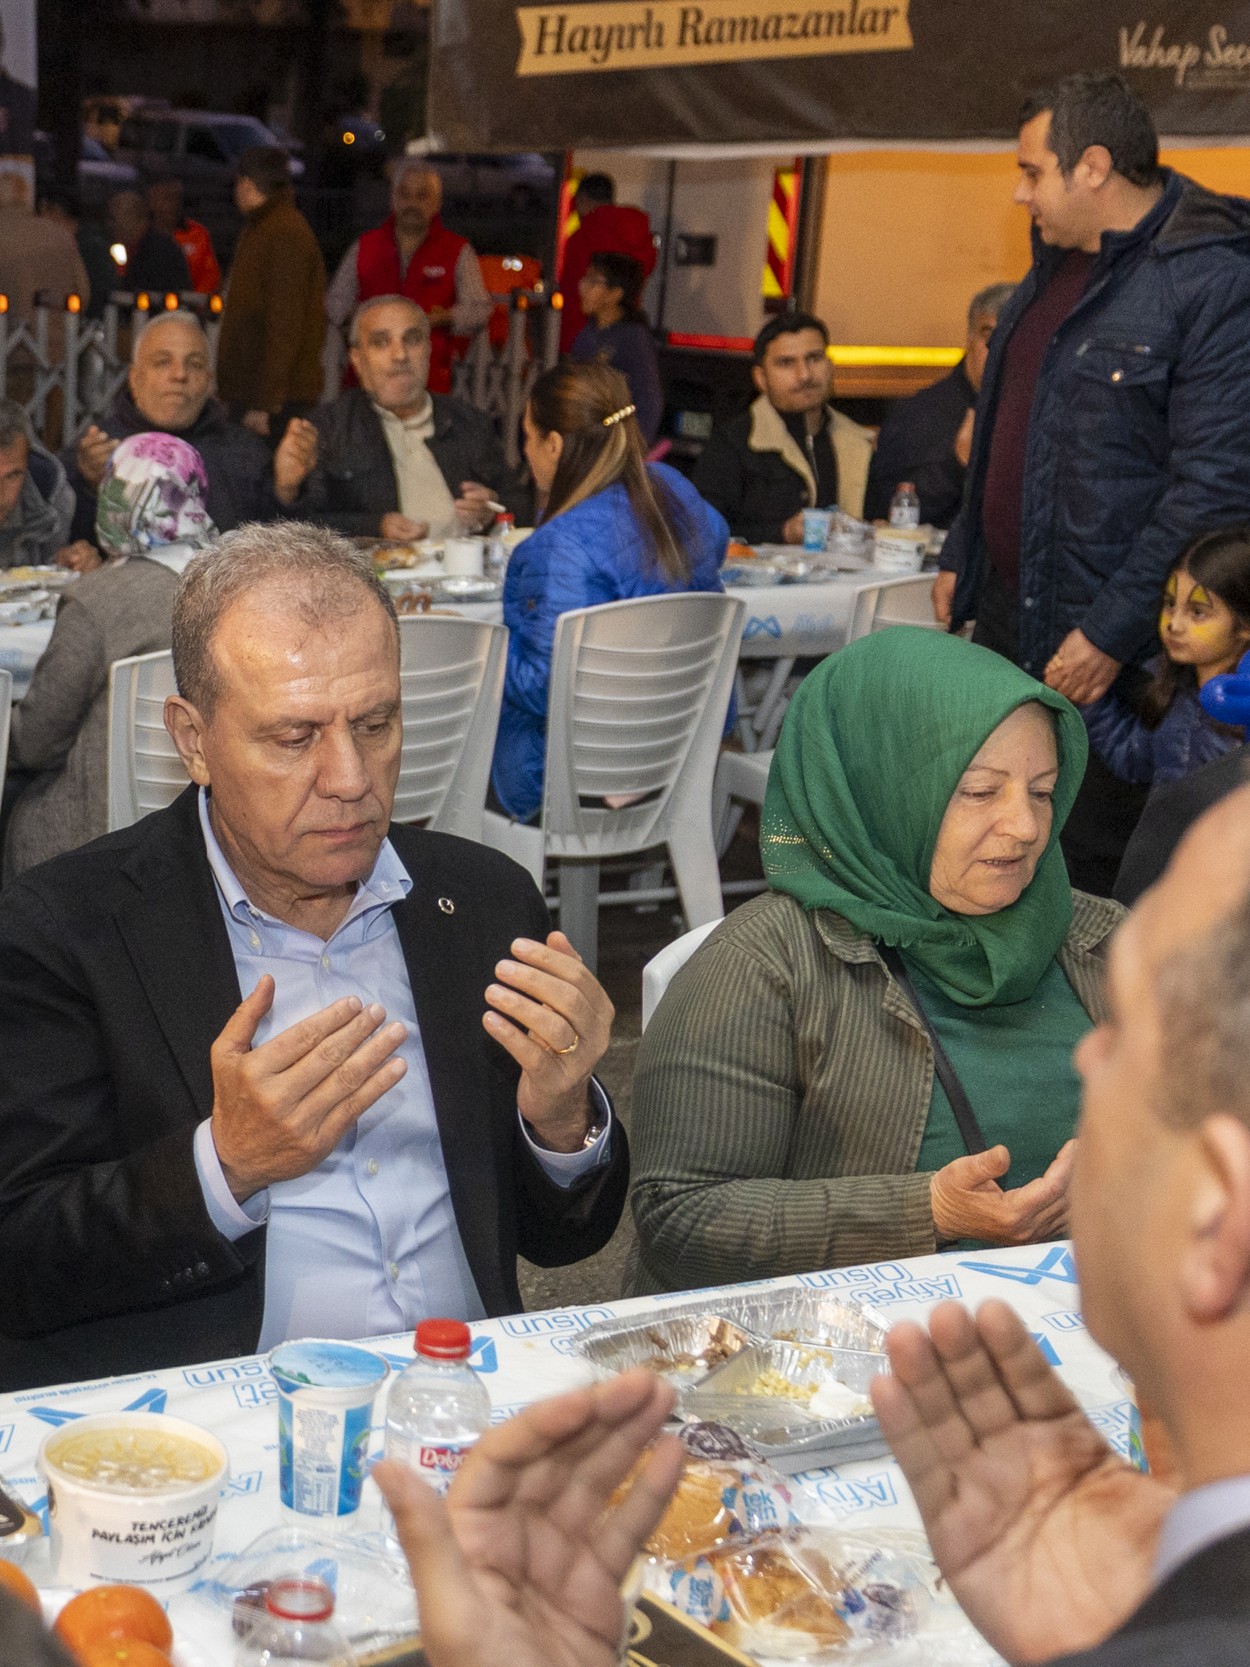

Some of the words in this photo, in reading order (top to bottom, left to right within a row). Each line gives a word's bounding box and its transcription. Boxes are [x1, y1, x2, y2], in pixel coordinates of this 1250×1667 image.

[533, 9, 665, 64] Hayırlı
[676, 2, 901, 48] Ramazanlar
[1118, 21, 1201, 86] Vahap
[801, 1262, 909, 1289] Olsun
[854, 1275, 957, 1304] Afiyet
[818, 1475, 893, 1508] Afiy
[91, 1528, 156, 1546] PAYLAŞIM
